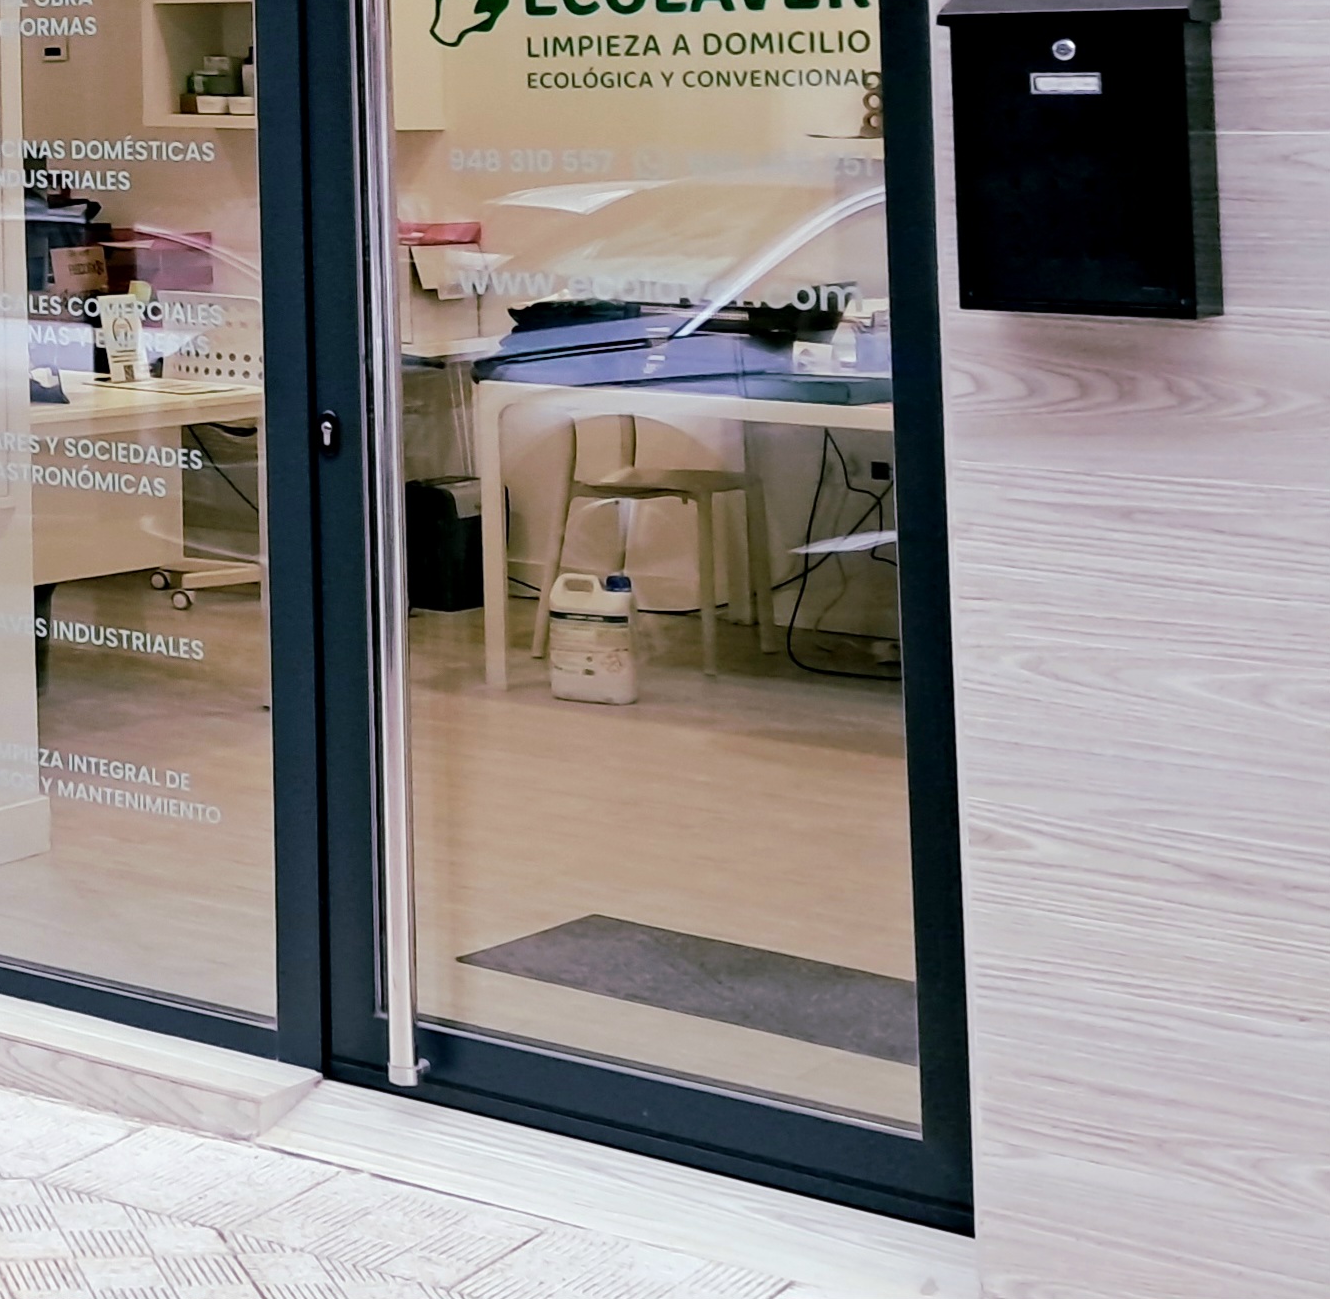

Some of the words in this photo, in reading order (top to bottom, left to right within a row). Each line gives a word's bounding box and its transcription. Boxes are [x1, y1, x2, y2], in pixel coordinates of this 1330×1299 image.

[526, 33, 662, 59] LIMPIEZA
[672, 33, 691, 56] A
[702, 29, 871, 56] DOMICILIO
[526, 67, 653, 89] ECOLÓGICA
[661, 72, 674, 88] Y
[681, 68, 871, 88] CONVENCIONAL
[71, 133, 215, 162] DOMÉSTICAS
[450, 147, 501, 172] 948
[509, 147, 554, 172] 310
[561, 147, 614, 172] 557
[67, 297, 224, 326] COMERCIALES
[45, 438, 61, 454] Y
[64, 438, 203, 470] SOCIEDADES
[52, 620, 205, 661] INDUSTRIALES
[68, 752, 160, 788] INTEGRAL
[166, 770, 191, 792] DE
[41, 776, 54, 795] Y
[57, 779, 222, 825] MANTENIMIENTO
